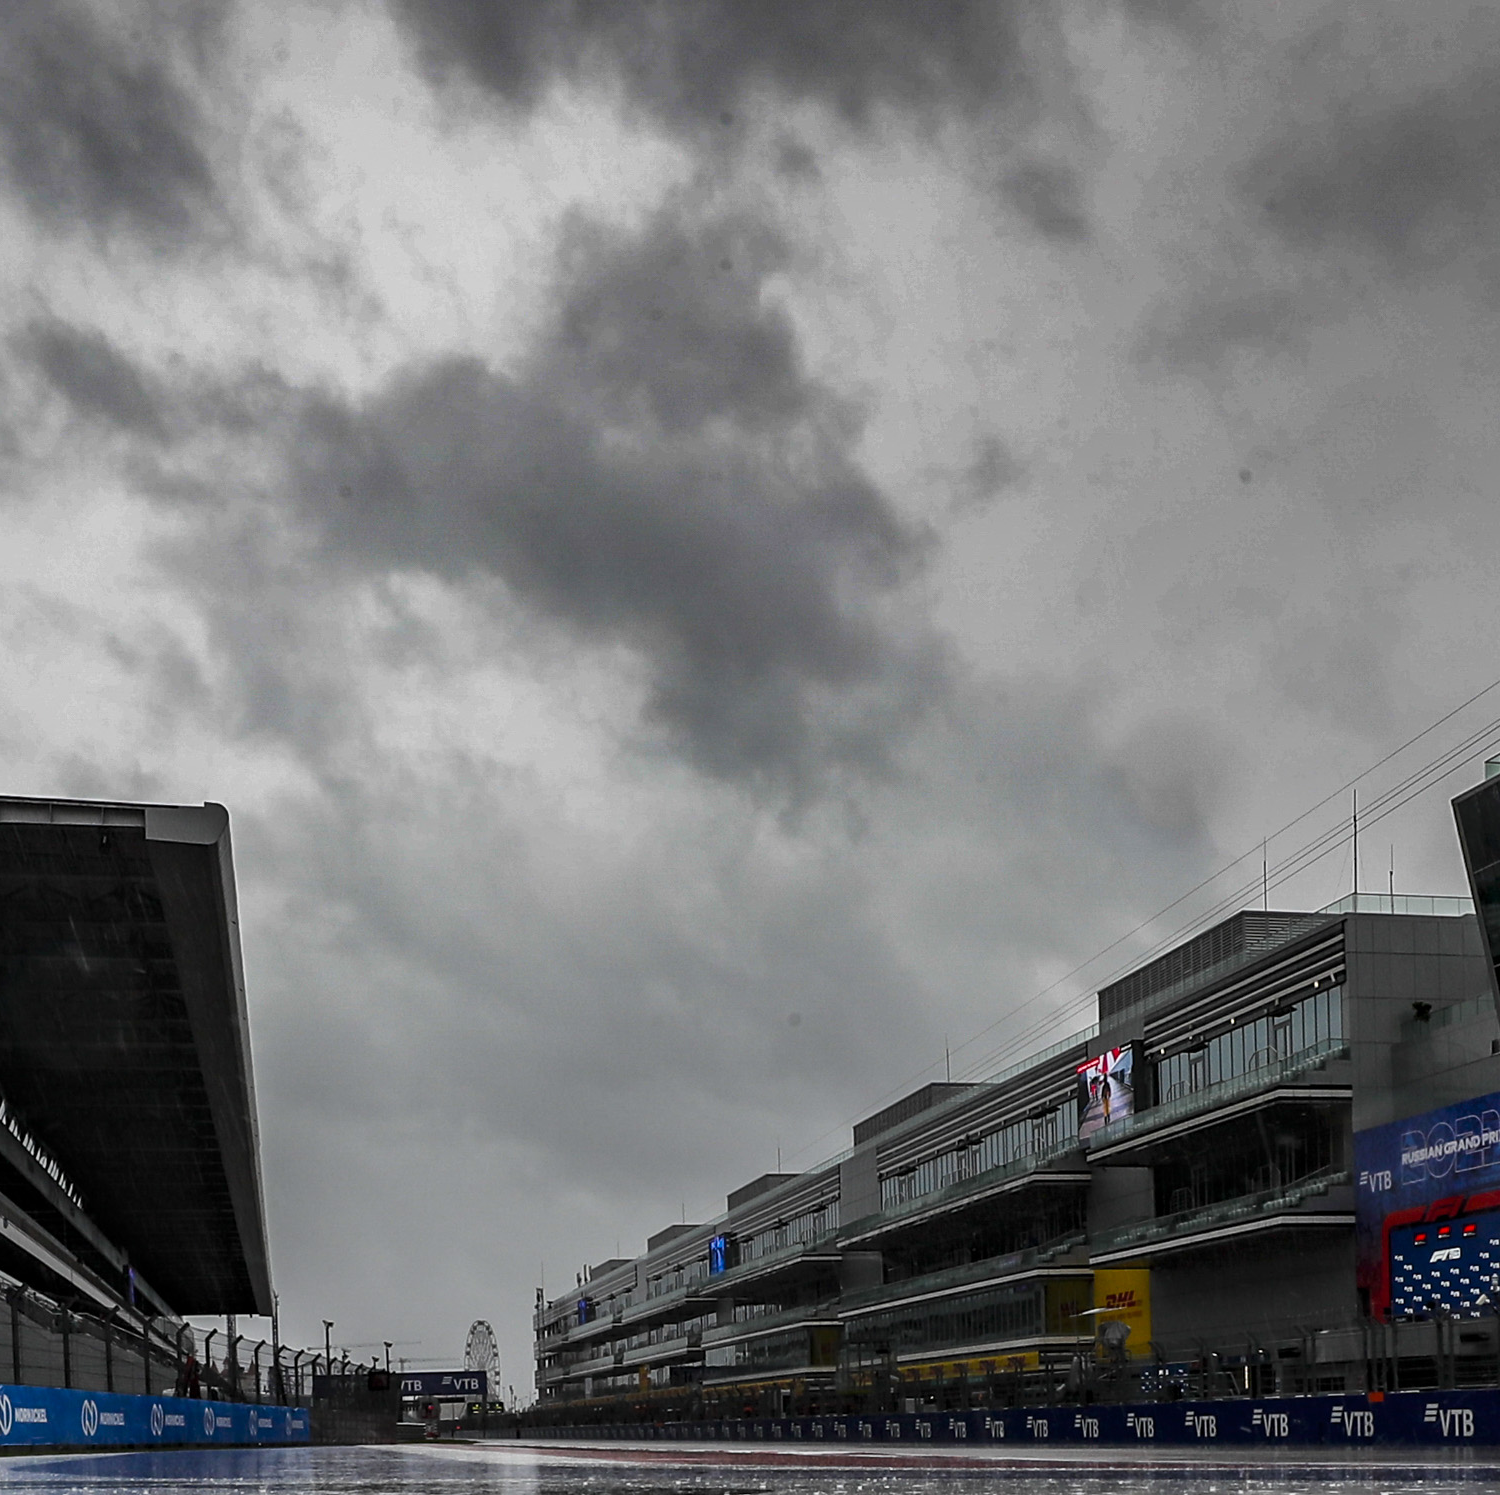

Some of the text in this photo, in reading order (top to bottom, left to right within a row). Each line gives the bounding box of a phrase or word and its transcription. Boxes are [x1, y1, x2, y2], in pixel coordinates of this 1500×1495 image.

[1401, 1144, 1444, 1166] RUSSIAN
[1443, 1135, 1481, 1156] GRAND
[1368, 1170, 1392, 1193] VTB
[1105, 1290, 1136, 1309] DHL
[453, 1379, 479, 1390] VTB
[954, 1421, 967, 1438] VTB
[991, 1420, 1005, 1438] VTB
[1032, 1419, 1049, 1438] VTB
[1081, 1418, 1099, 1438] VTB
[1134, 1417, 1155, 1438] VTB
[1194, 1415, 1217, 1438] VTB
[1262, 1413, 1289, 1437] VTB
[1344, 1411, 1375, 1437] VTB
[1439, 1409, 1475, 1437] VTB
